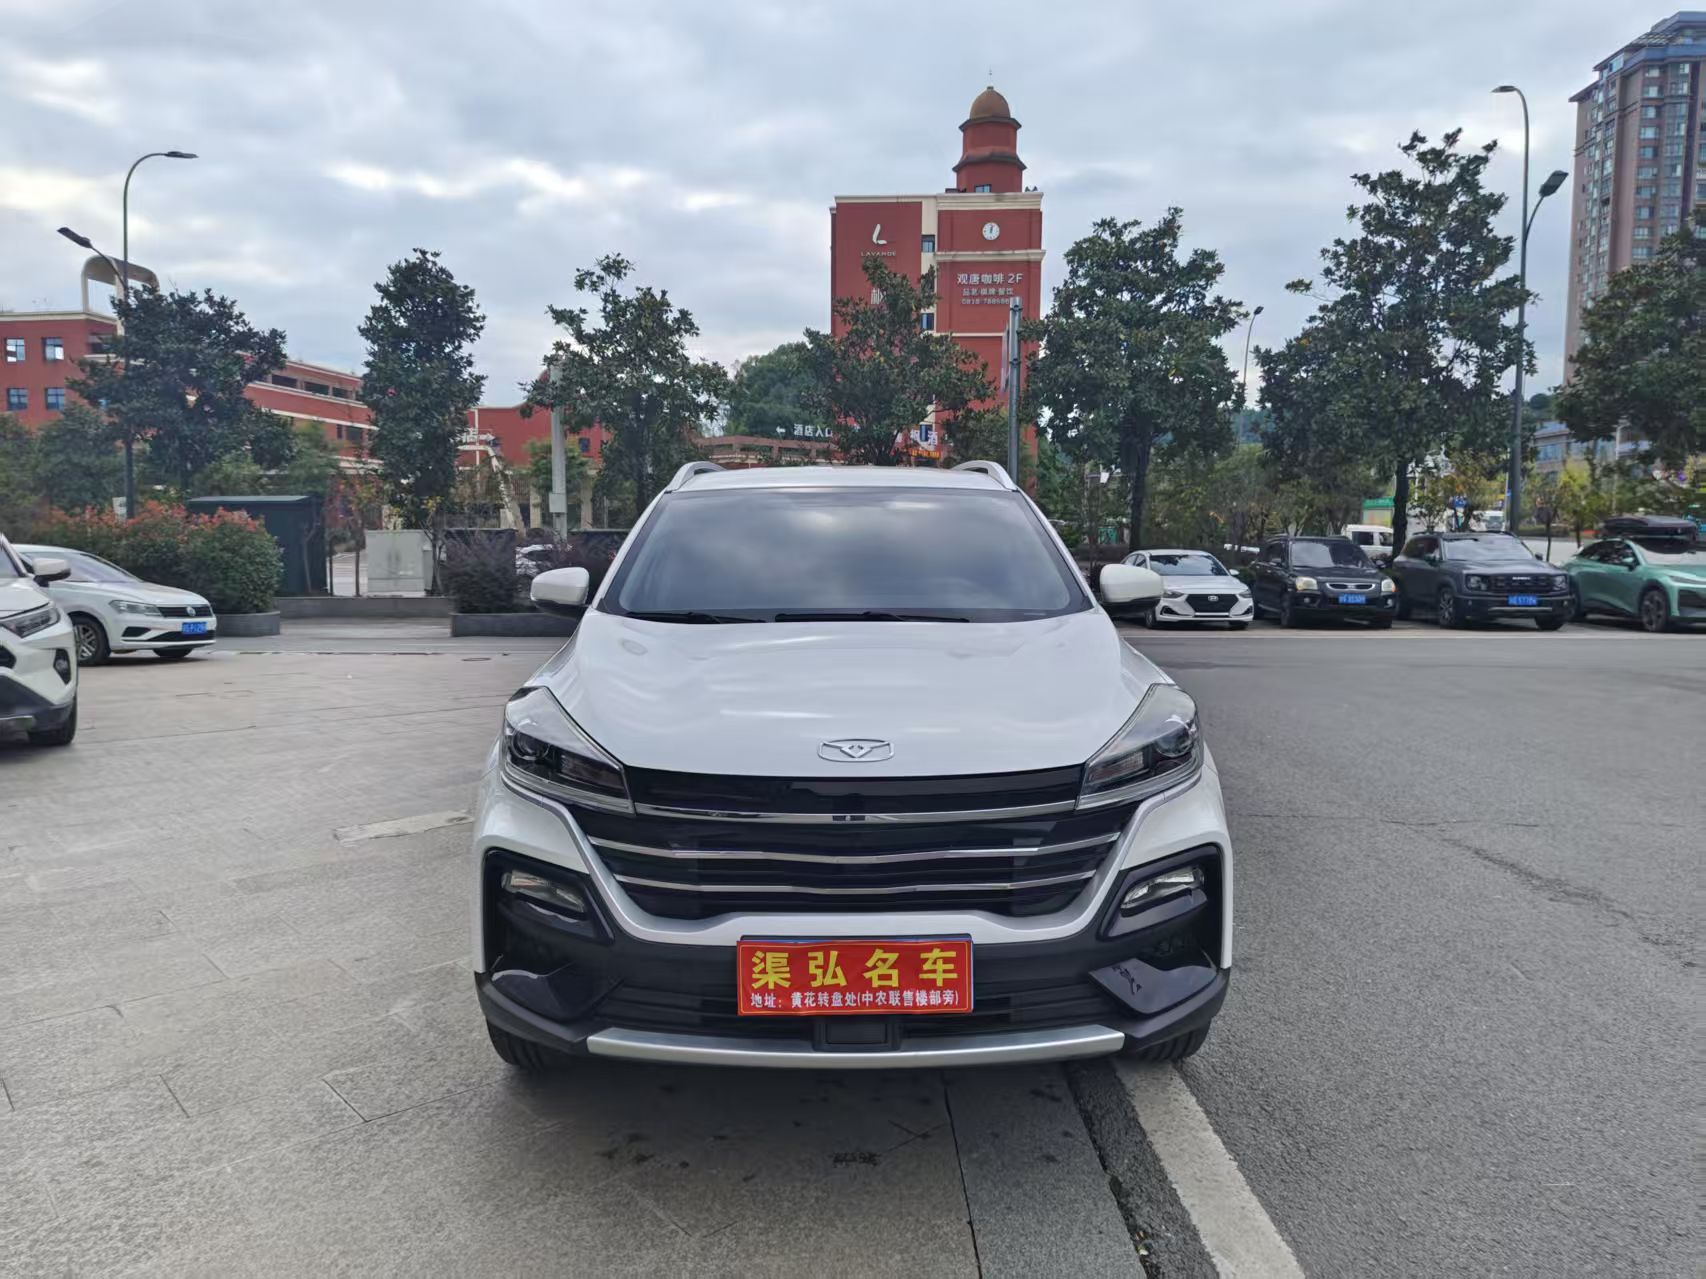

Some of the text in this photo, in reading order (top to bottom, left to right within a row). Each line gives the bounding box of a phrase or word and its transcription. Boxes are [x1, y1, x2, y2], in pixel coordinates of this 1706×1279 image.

[1008, 273, 1023, 283] 2F
[793, 423, 833, 438] 酒店入口
[751, 949, 959, 989] 渠弘名车
